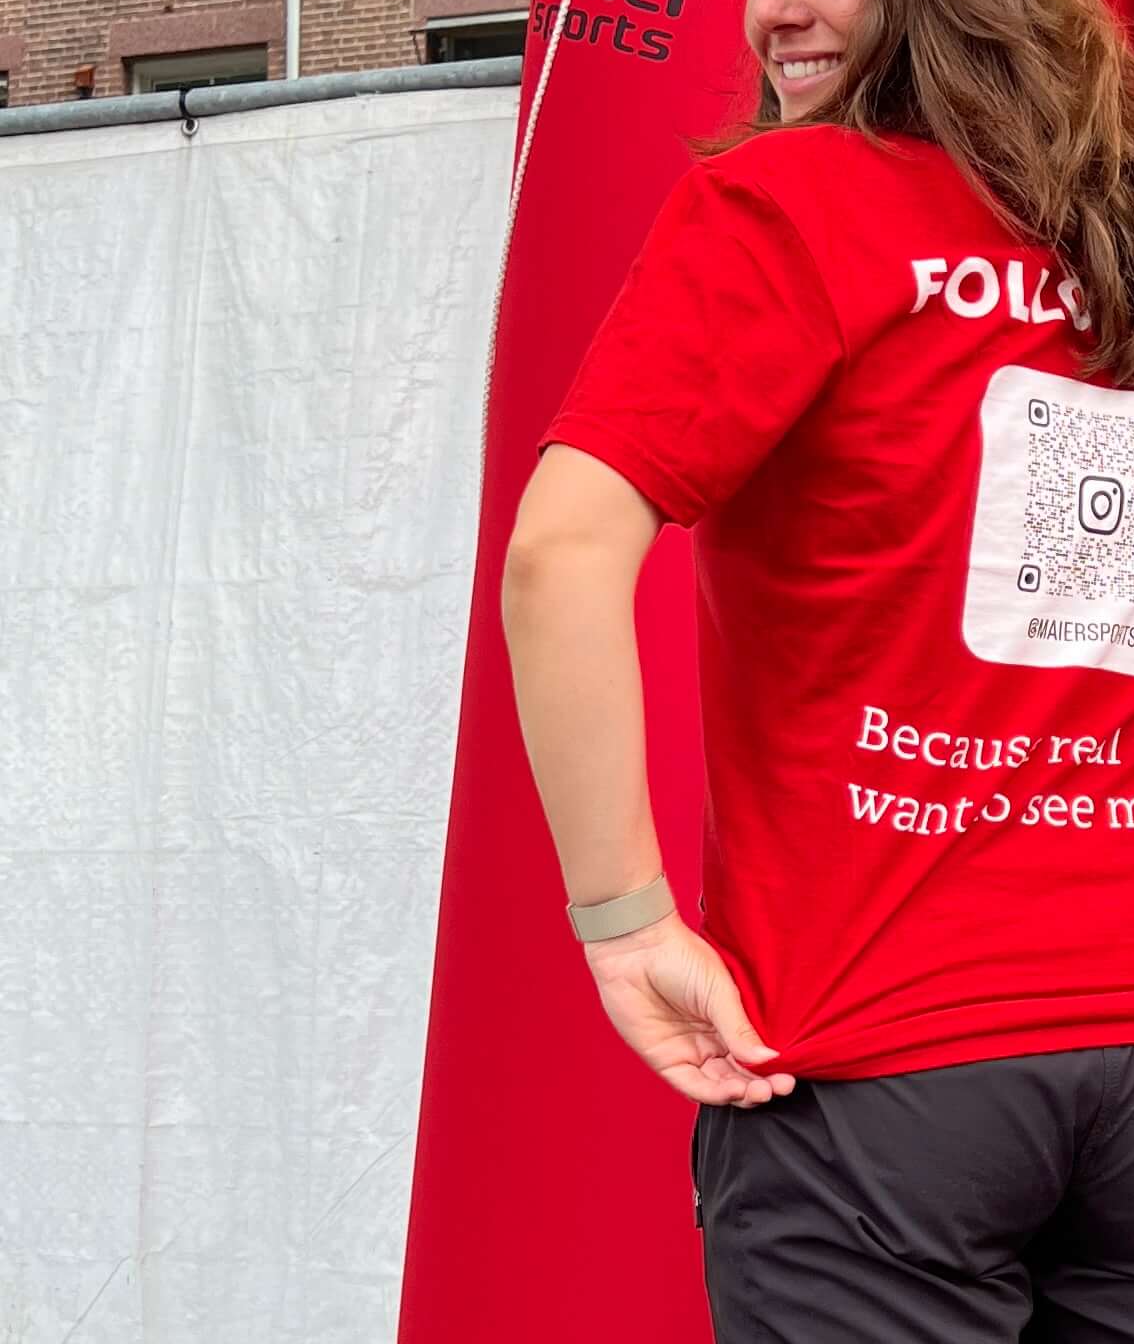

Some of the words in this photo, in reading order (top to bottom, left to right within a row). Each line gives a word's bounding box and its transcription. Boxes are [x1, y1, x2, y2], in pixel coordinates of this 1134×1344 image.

[909, 256, 1092, 332] FOLLO
[856, 705, 1043, 770] Becaus
[847, 783, 974, 835] want
[973, 793, 1011, 823] o
[1021, 793, 1096, 829] see
